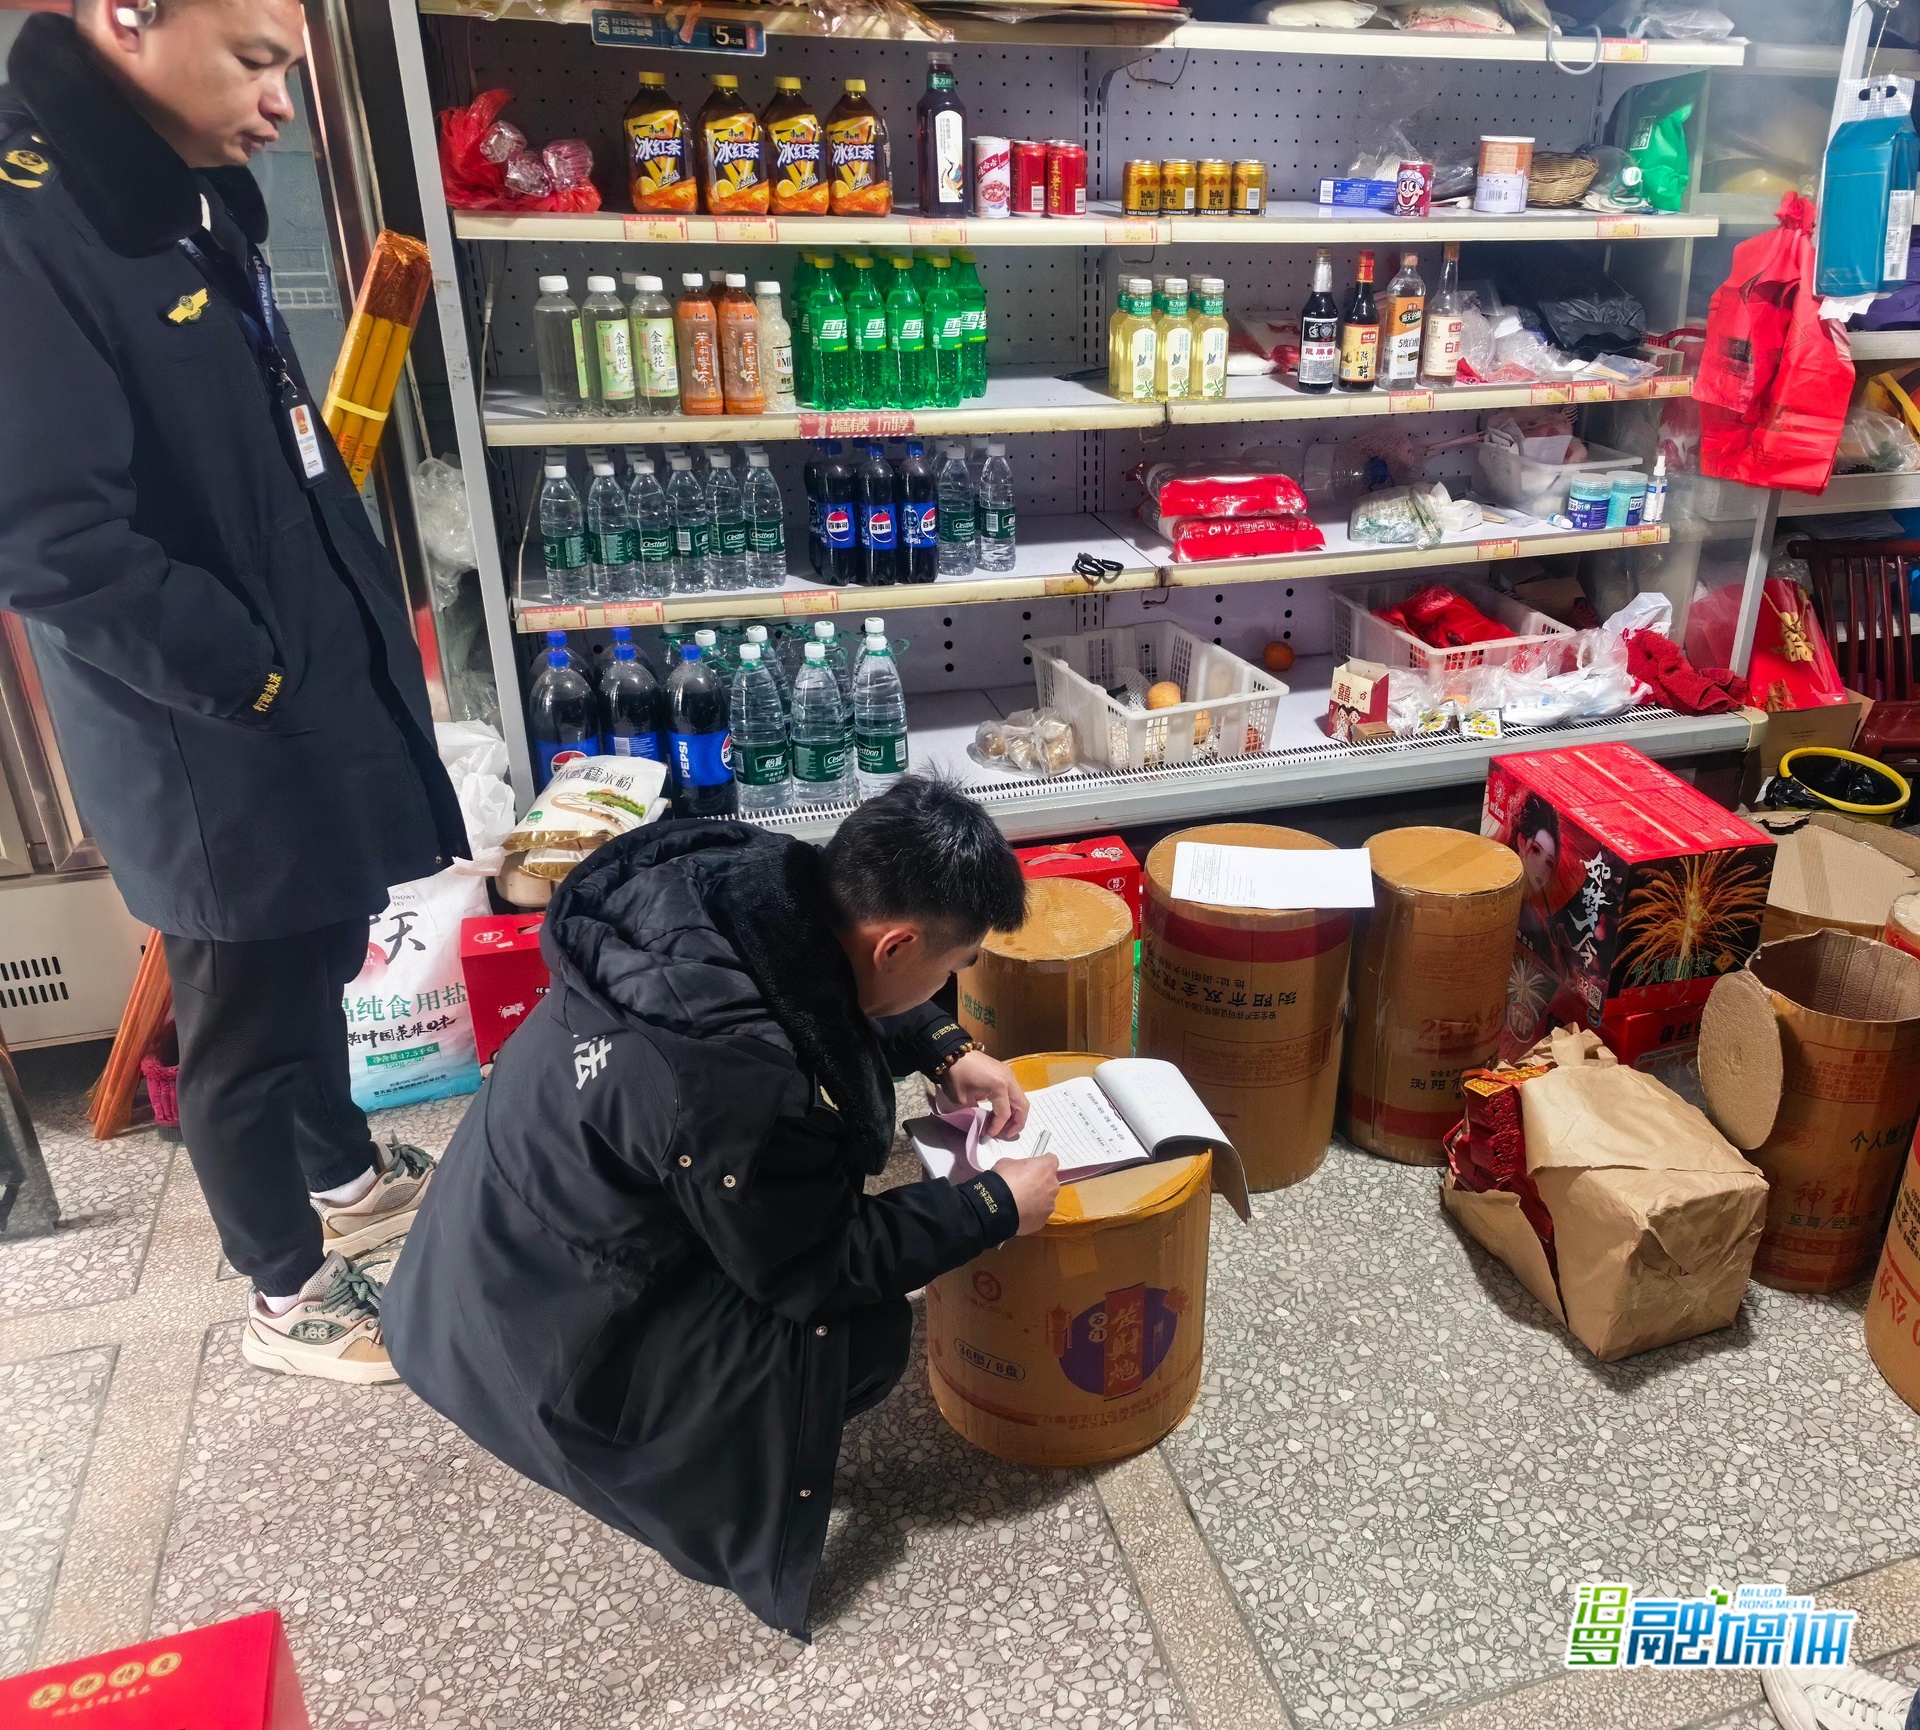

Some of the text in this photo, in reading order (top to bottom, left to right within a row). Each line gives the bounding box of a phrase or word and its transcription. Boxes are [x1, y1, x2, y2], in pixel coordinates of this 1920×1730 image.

[635, 137, 682, 161] 冰红茶
[714, 141, 760, 165] 冰红茶
[777, 142, 820, 165] 冰红茶
[832, 142, 875, 165] 冰红茶
[1050, 158, 1063, 208] 王老吉
[678, 741, 691, 779] PEPSI
[298, 1323, 329, 1341] Lee
